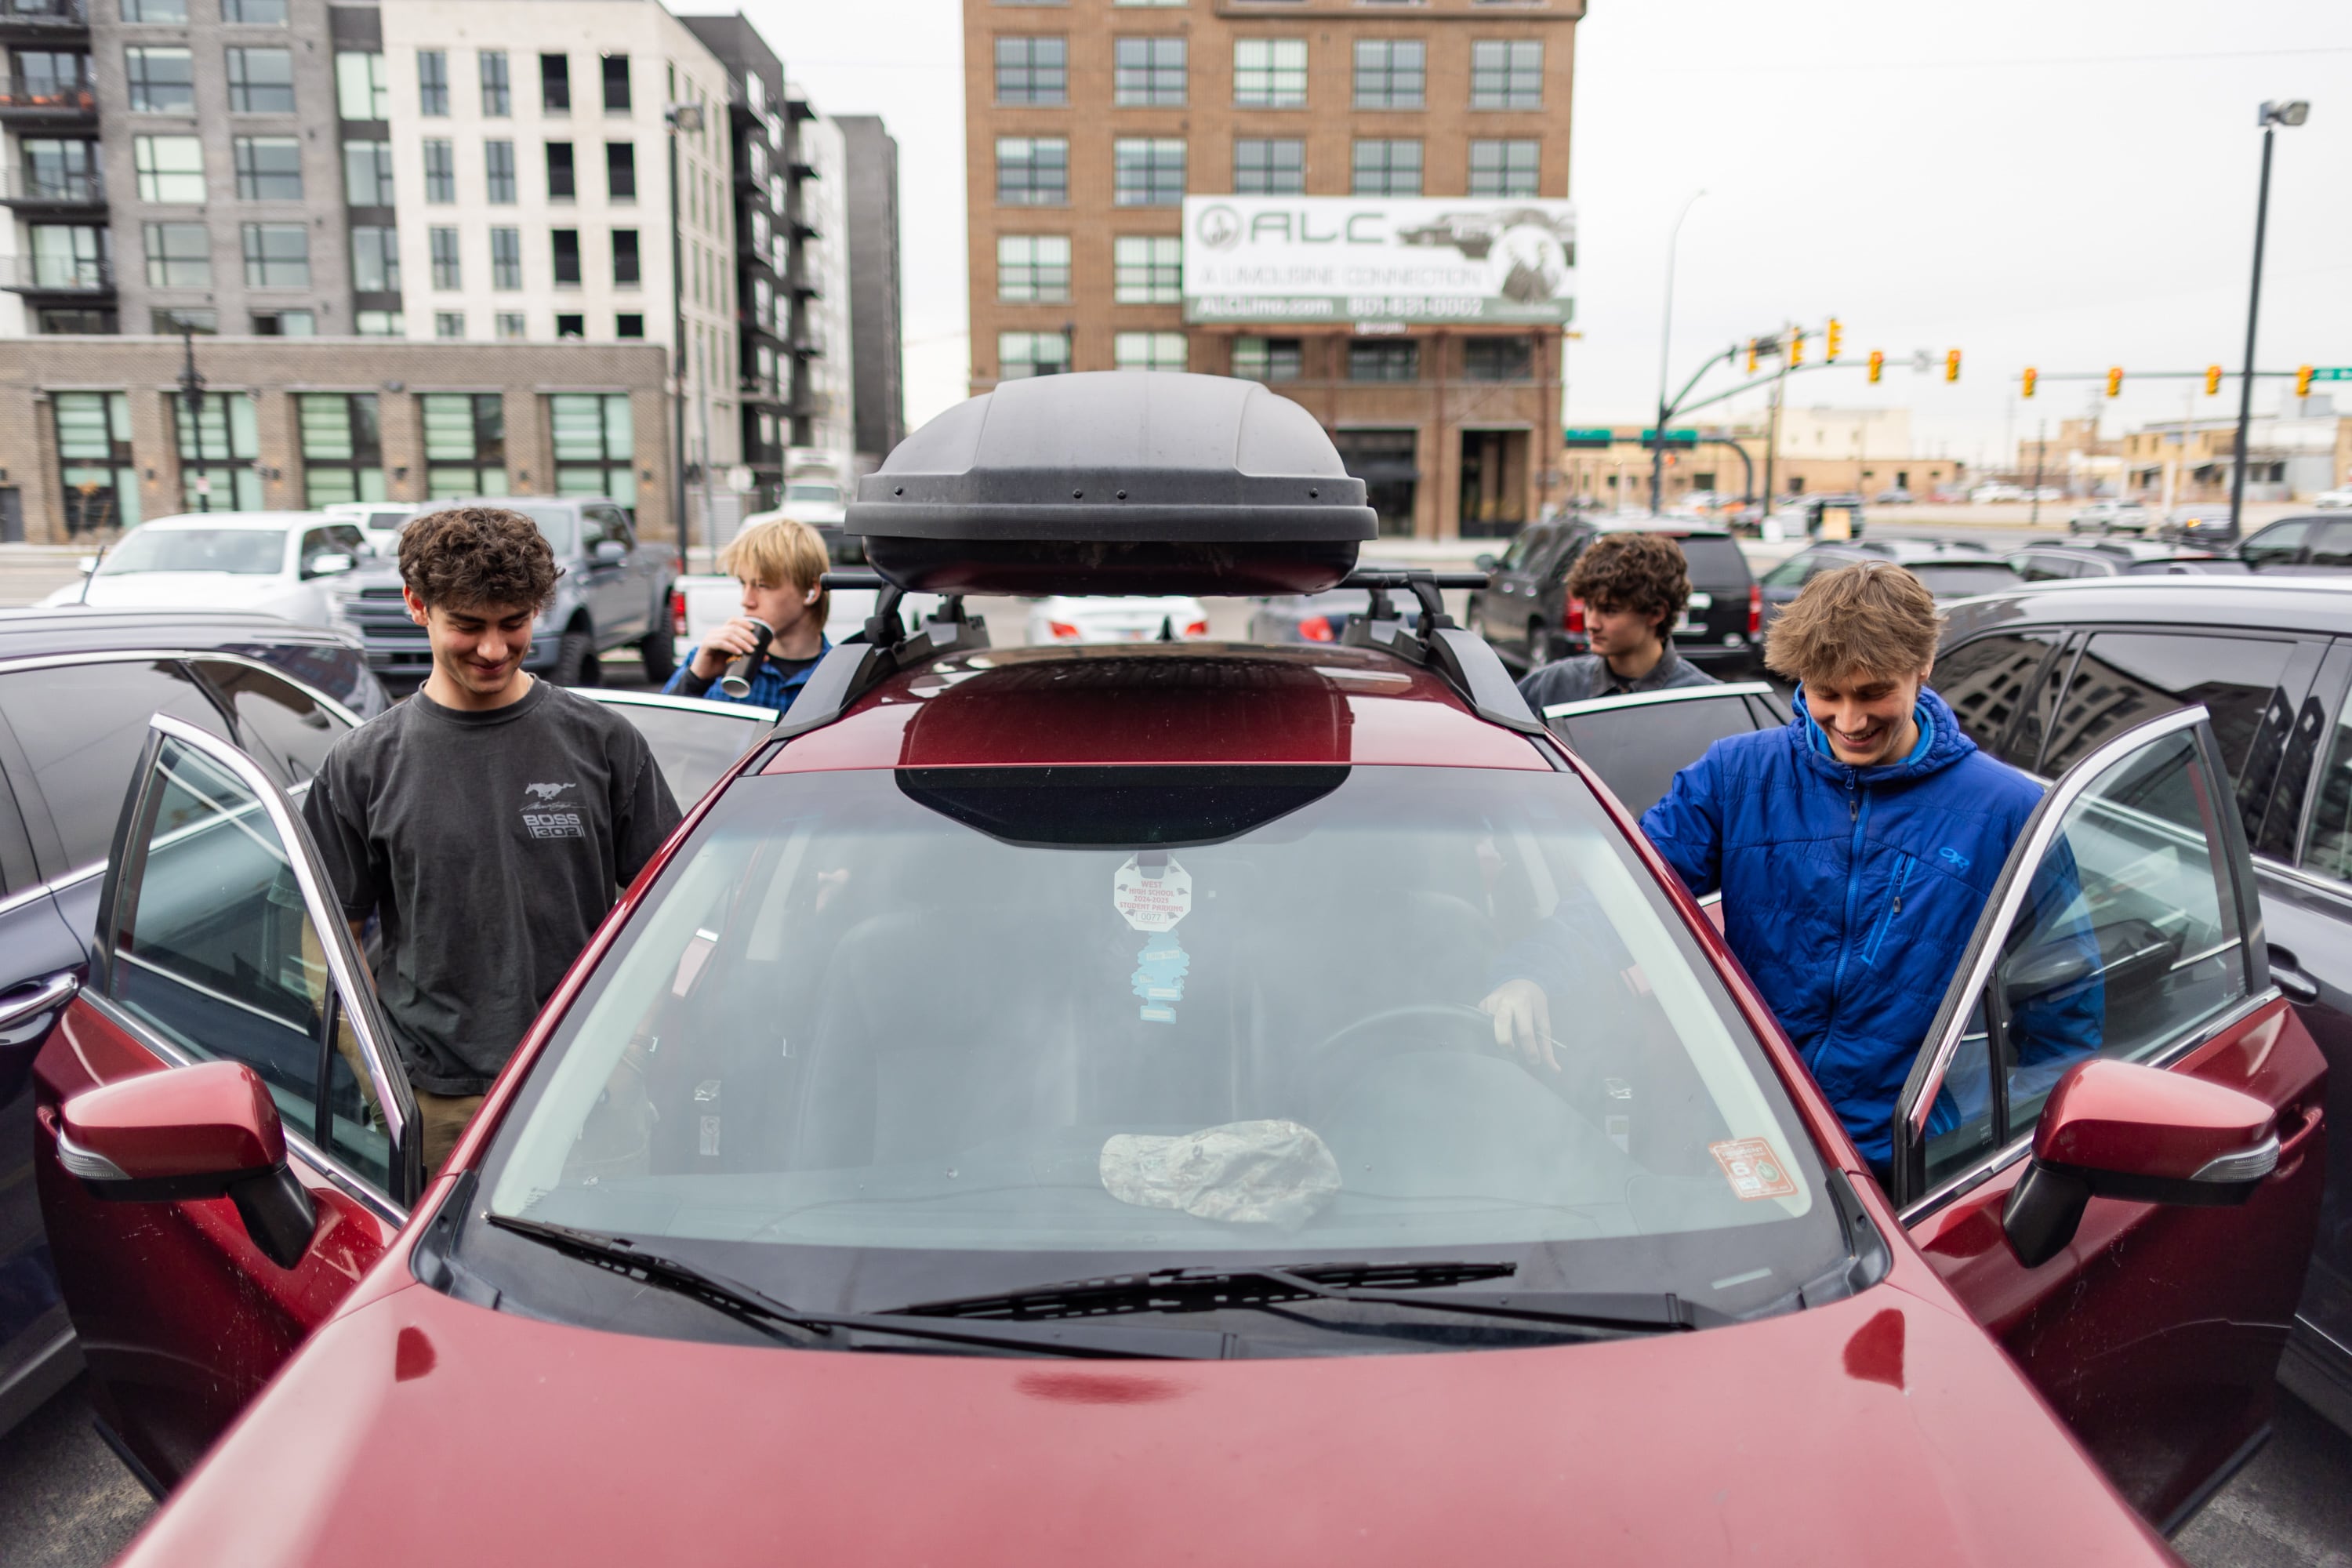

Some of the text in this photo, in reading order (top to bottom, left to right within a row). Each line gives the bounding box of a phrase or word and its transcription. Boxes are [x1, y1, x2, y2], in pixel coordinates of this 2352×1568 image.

[1251, 211, 1386, 244] ALC
[1199, 265, 1218, 285] A
[1345, 266, 1482, 287] CONNECTION
[523, 814, 581, 826] BOSS
[536, 827, 579, 837] 302
[1120, 902, 1150, 910] STUDENT
[1141, 913, 1162, 921] 0077
